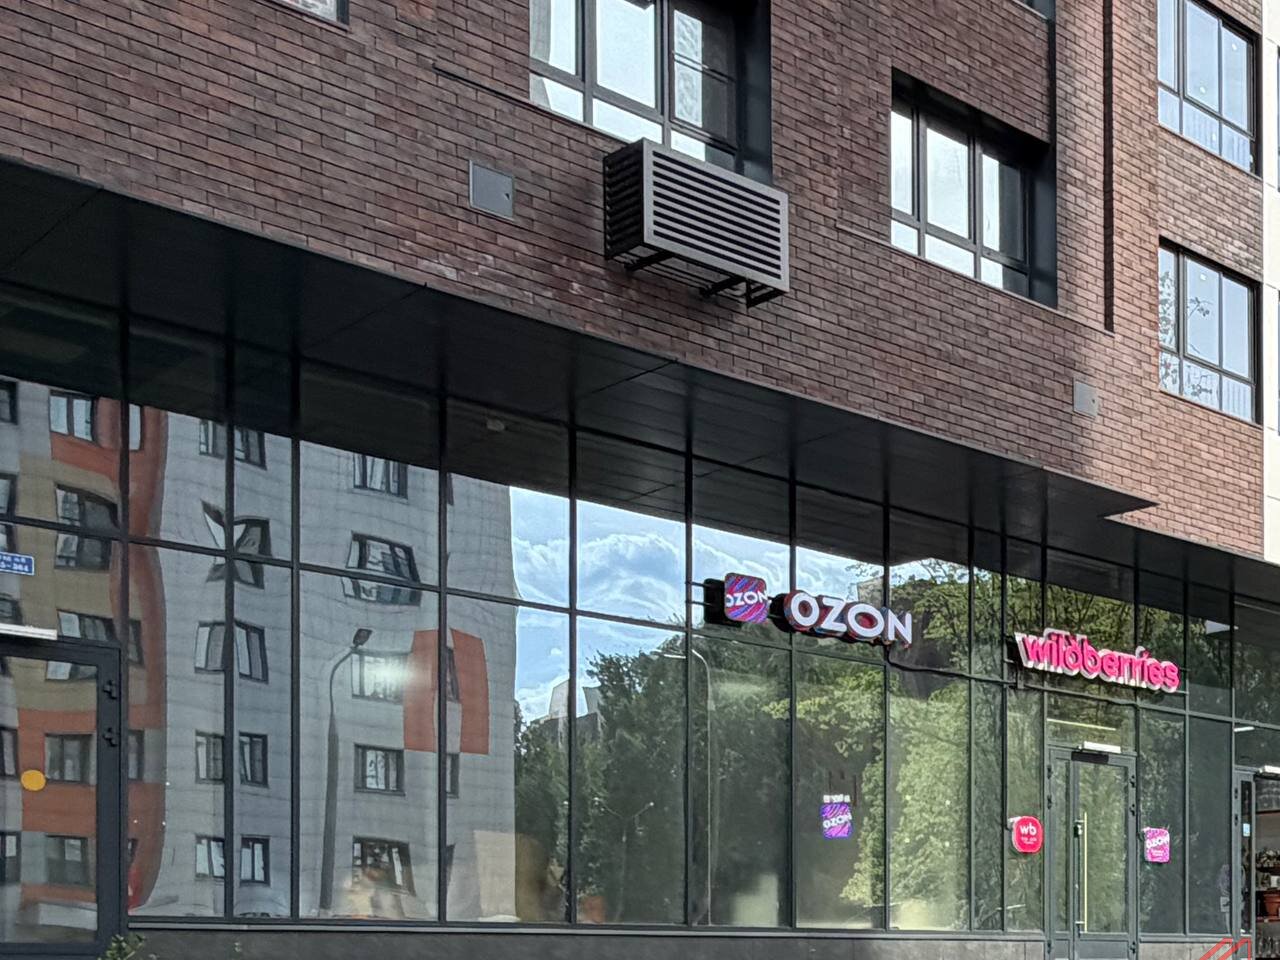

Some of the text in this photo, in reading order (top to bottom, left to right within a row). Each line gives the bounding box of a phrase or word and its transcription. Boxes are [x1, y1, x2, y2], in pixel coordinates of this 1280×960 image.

[726, 590, 772, 608] OZON
[788, 591, 913, 646] OZON
[1015, 628, 1181, 692] wildberries
[1019, 822, 1037, 836] wb
